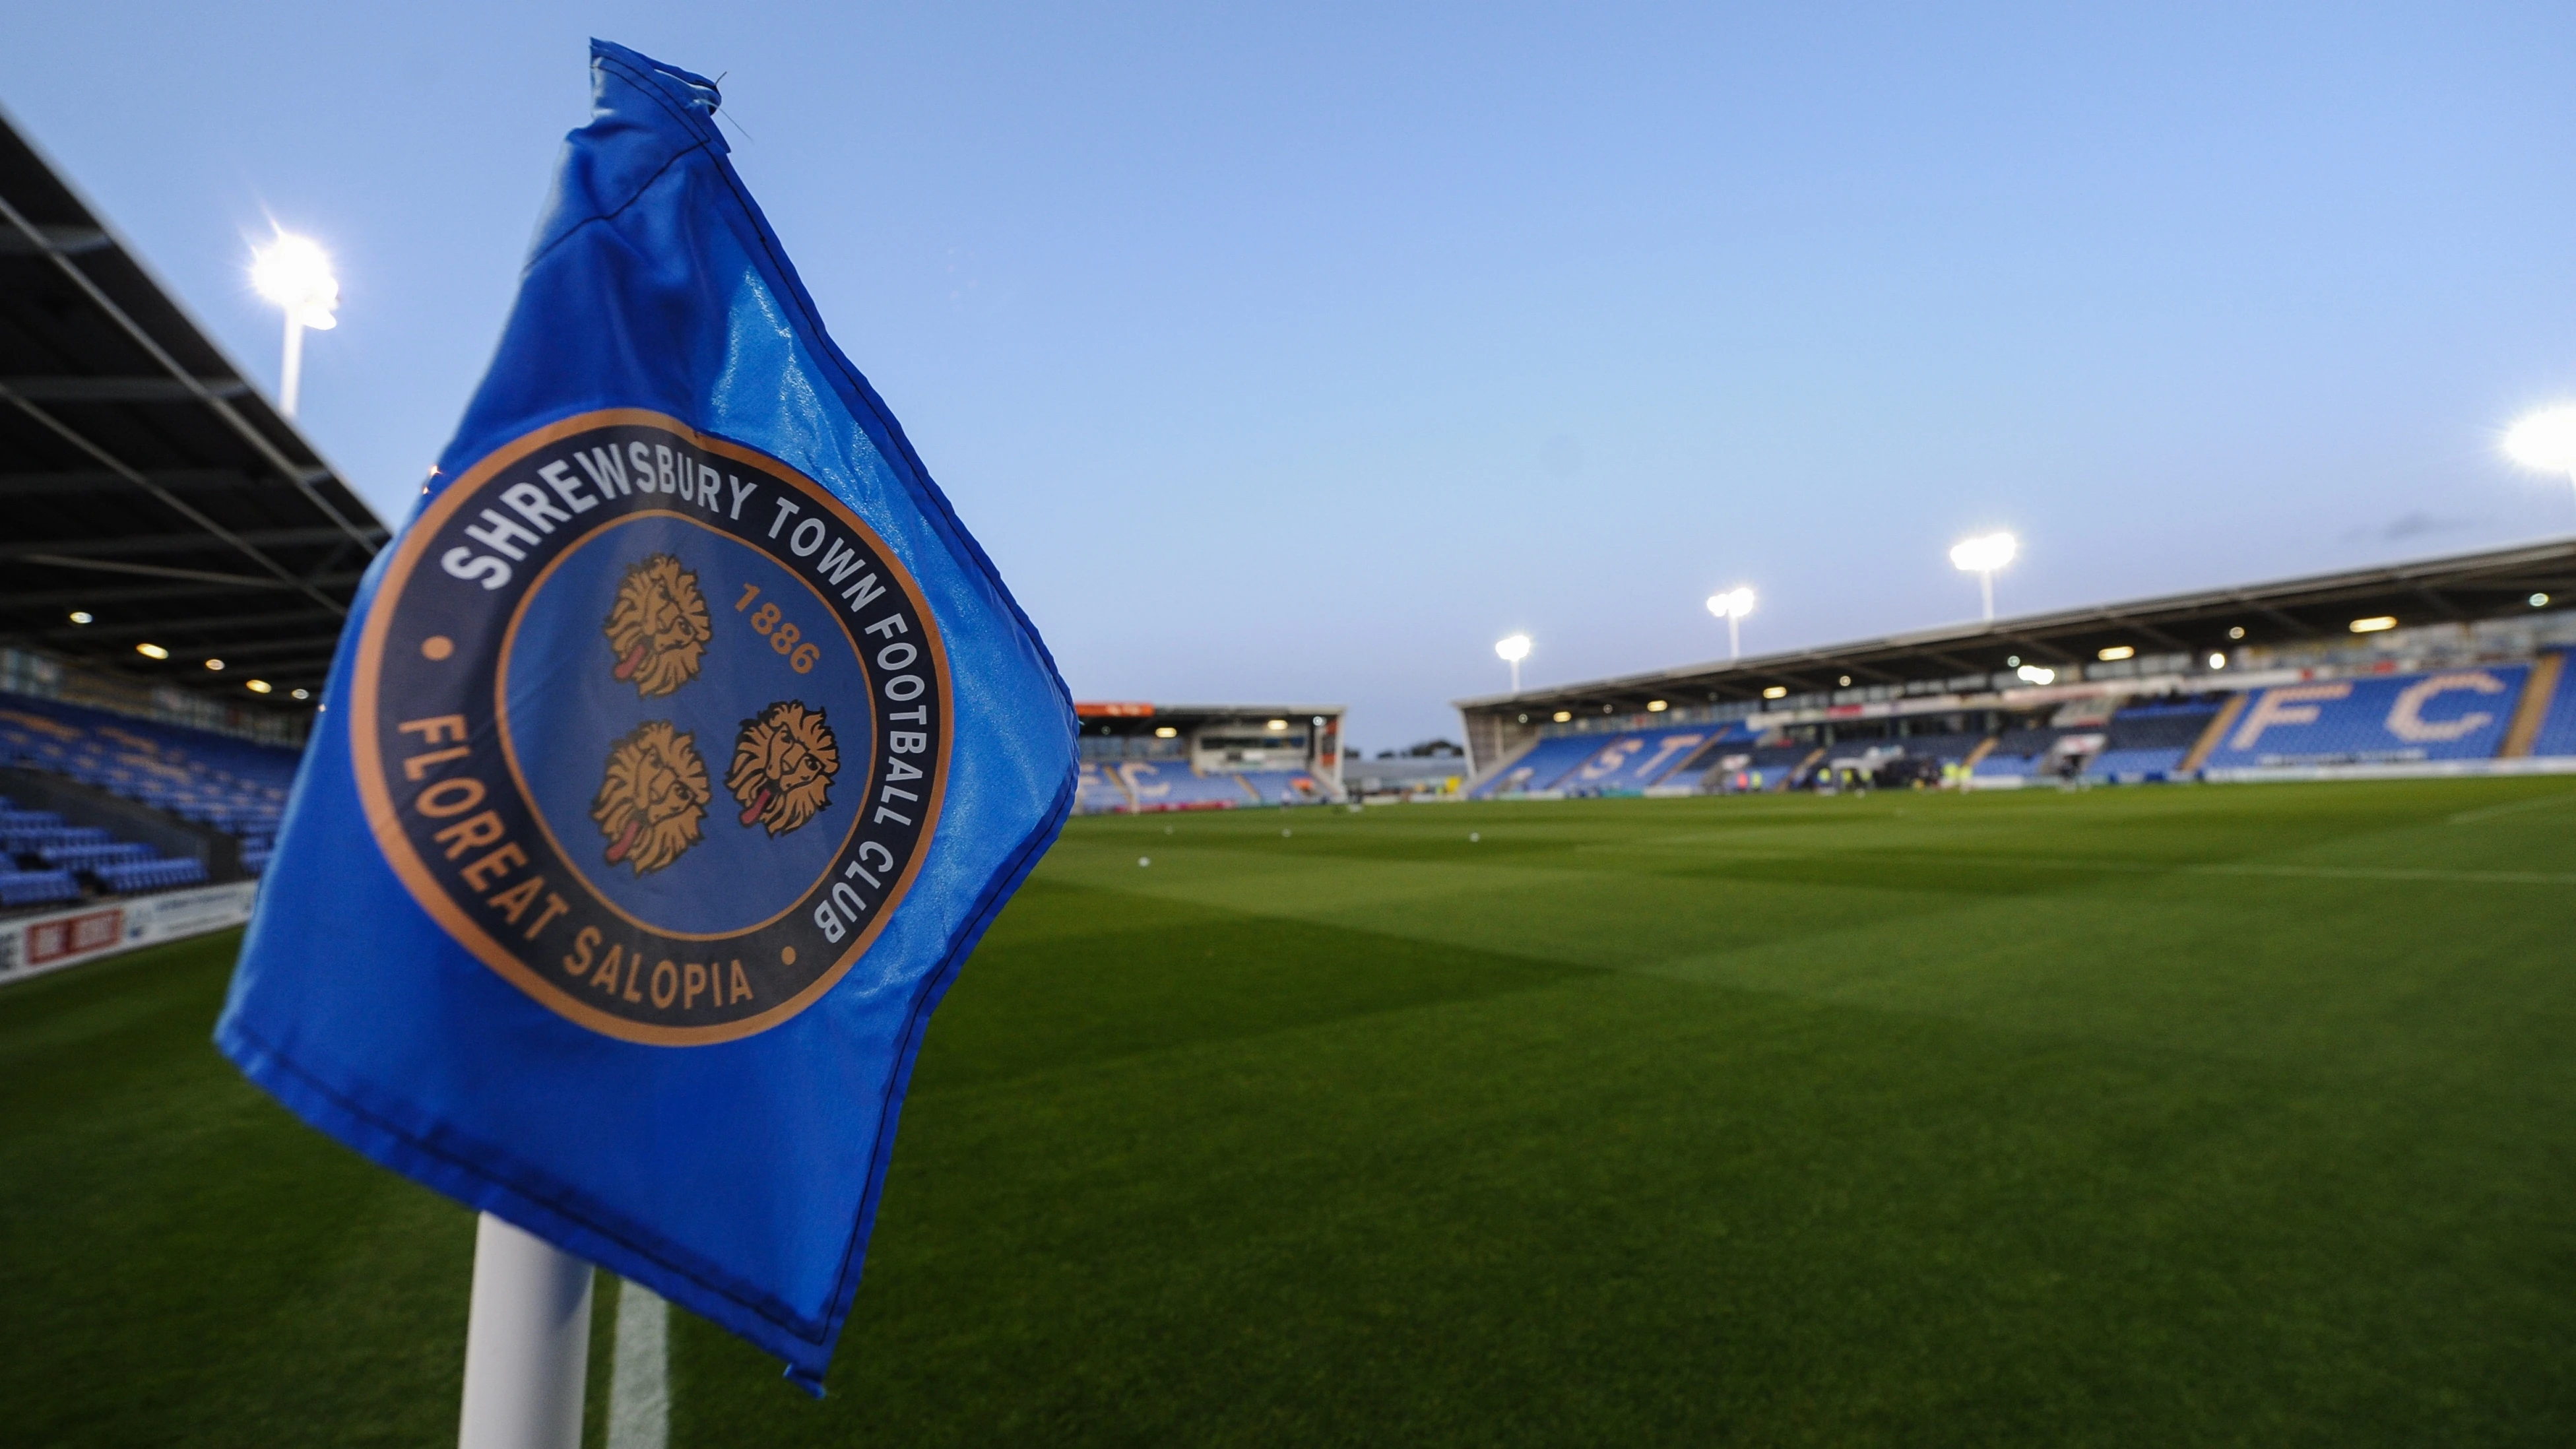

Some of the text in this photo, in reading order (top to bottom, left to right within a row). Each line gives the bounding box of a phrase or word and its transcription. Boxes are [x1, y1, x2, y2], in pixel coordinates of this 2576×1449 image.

[441, 441, 927, 944] SHREWSBURY TOWN FOOTBALL CLUB
[734, 583, 821, 674] 1886
[398, 714, 568, 939] FLOREAT
[564, 926, 754, 1010] SALOPIA
